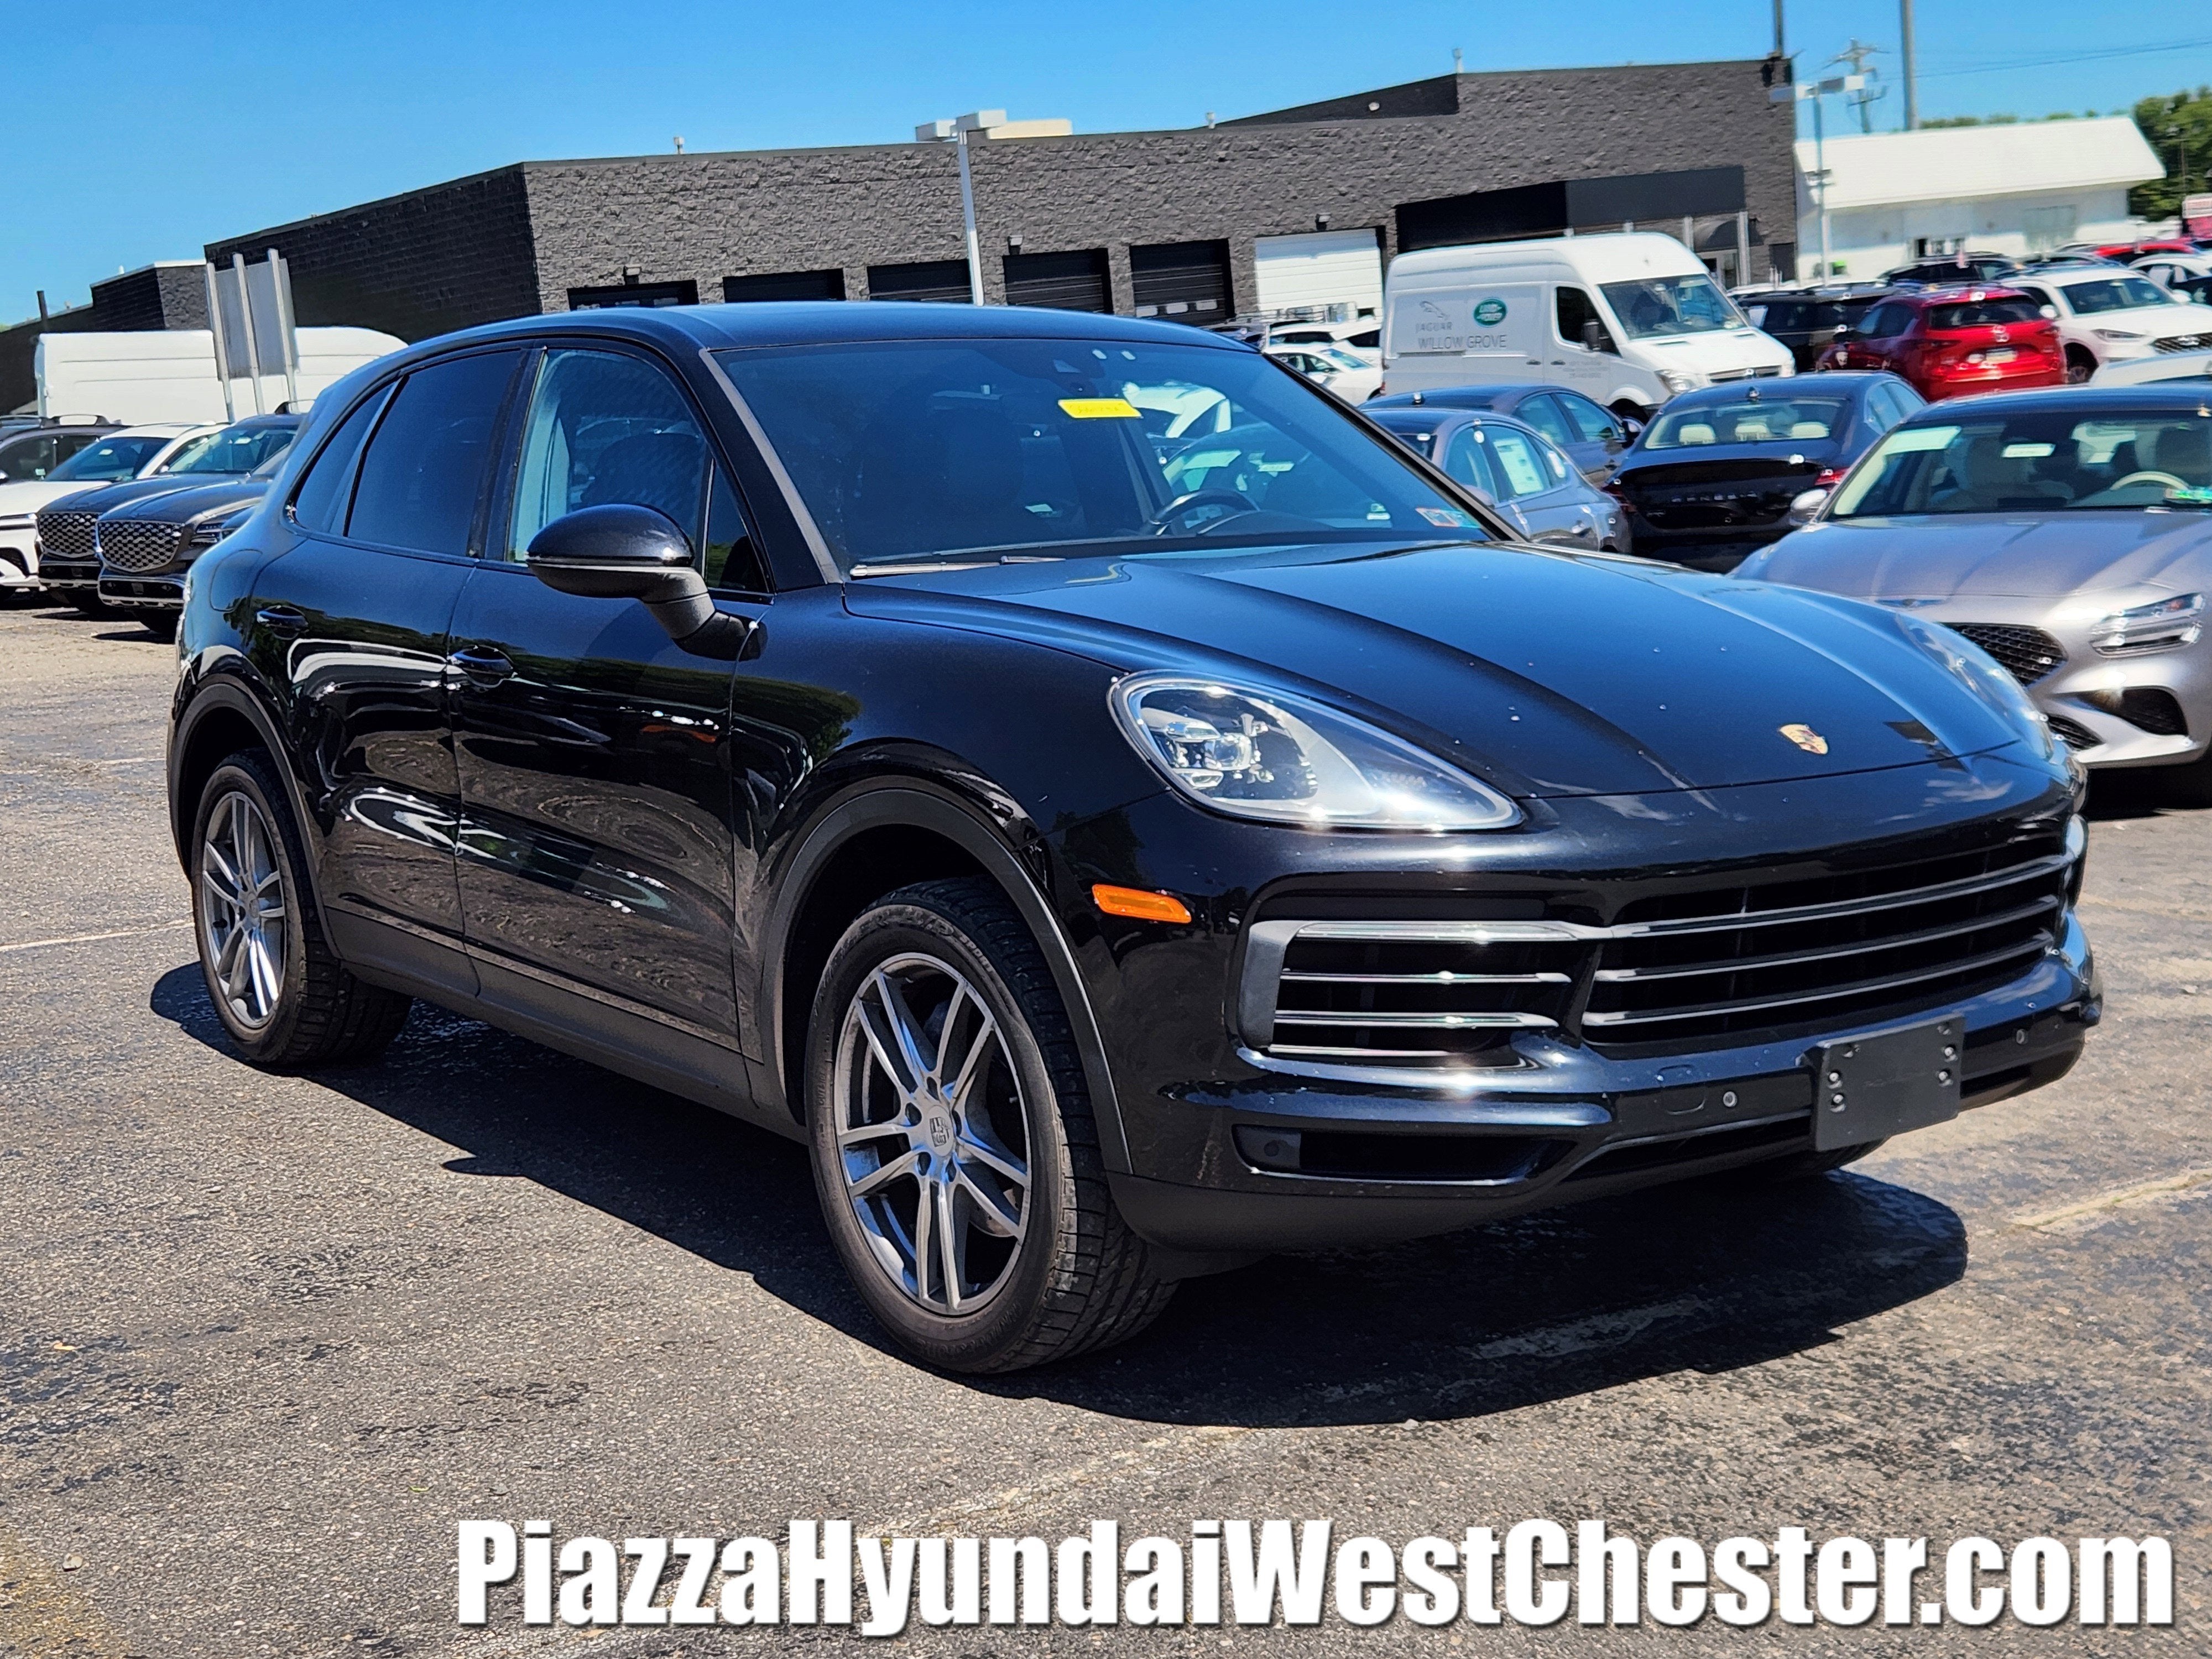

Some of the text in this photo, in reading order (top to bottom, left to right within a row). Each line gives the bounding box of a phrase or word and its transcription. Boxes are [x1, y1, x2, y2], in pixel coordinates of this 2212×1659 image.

[1416, 322, 1452, 333] JAGUAR
[1418, 335, 1507, 349] WILLOW GROVE
